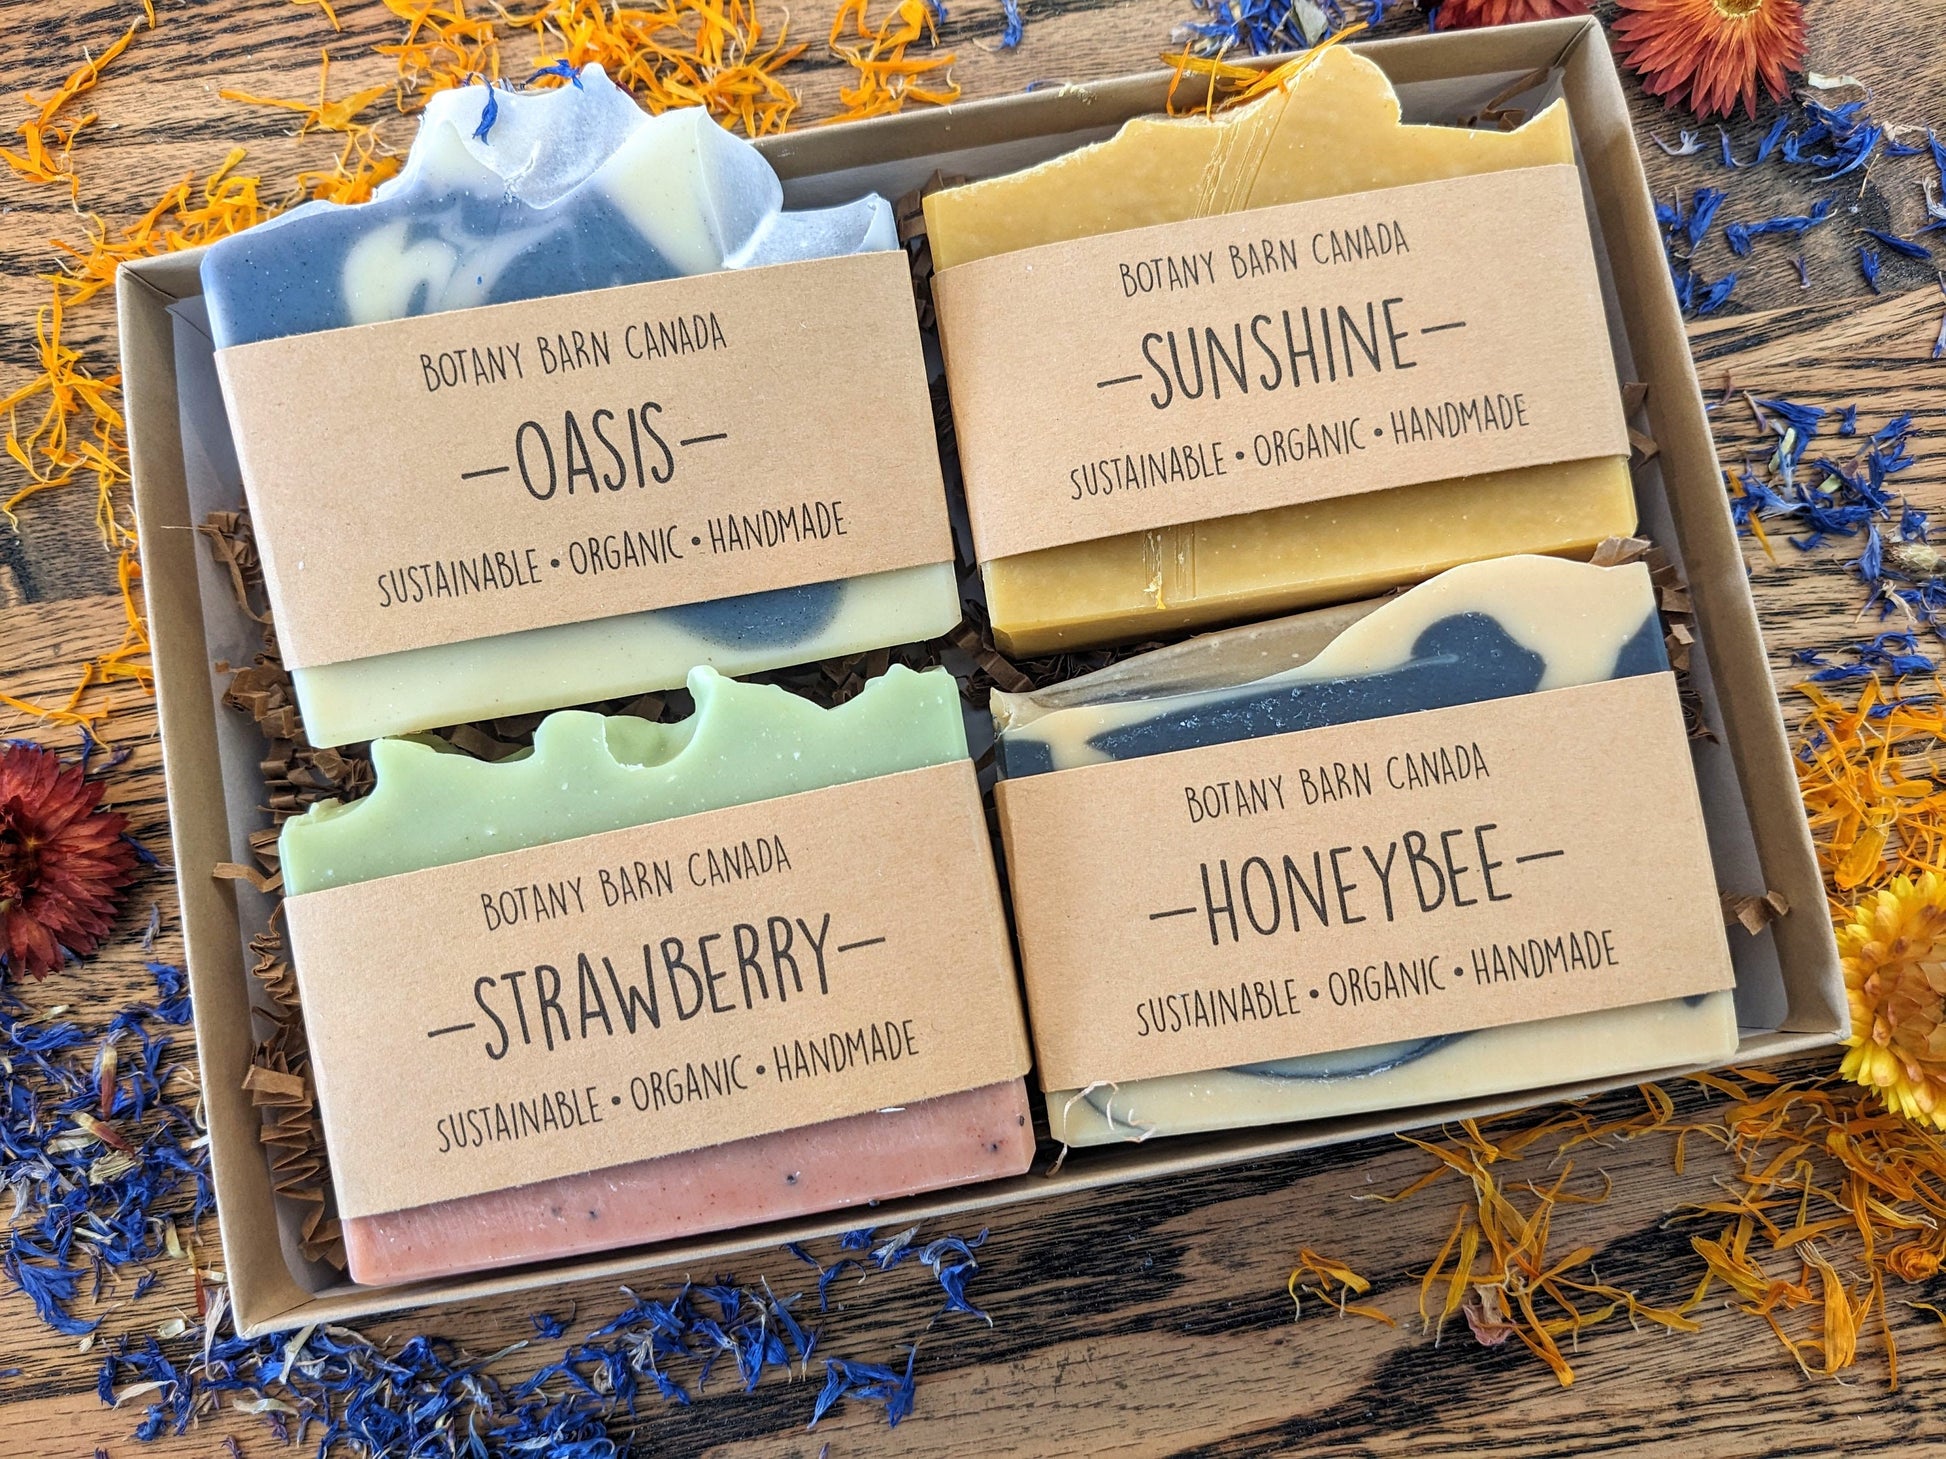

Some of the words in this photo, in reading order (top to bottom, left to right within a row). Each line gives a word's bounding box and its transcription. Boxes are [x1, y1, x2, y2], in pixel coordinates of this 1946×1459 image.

[1118, 250, 1215, 298] BOTANY
[1228, 238, 1298, 280] BARN
[1311, 219, 1410, 265] CANADA
[419, 342, 524, 393] BOTANY
[536, 330, 611, 375] BARN
[624, 311, 728, 361] CANADA
[1070, 441, 1228, 501] SUSTAINABLE
[1253, 417, 1366, 467] ORGANIC
[1390, 393, 1530, 445] HANDMADE
[377, 548, 543, 608] SUSTAINABLE
[568, 524, 684, 576] ORGANIC
[707, 500, 848, 555] HANDMADE
[1184, 774, 1285, 824] BOTANY
[1298, 762, 1372, 806] BARN
[1386, 741, 1491, 791] CANADA
[480, 876, 585, 932] BOTANY
[598, 859, 674, 908] BARN
[687, 834, 792, 887] CANADA
[1136, 978, 1302, 1037] SUSTAINABLE
[1328, 955, 1446, 1007] ORGANIC
[1470, 929, 1620, 986] HANDMADE
[436, 1085, 604, 1154] SUSTAINABLE
[630, 1053, 749, 1112] ORGANIC
[772, 1017, 921, 1083] HANDMADE
